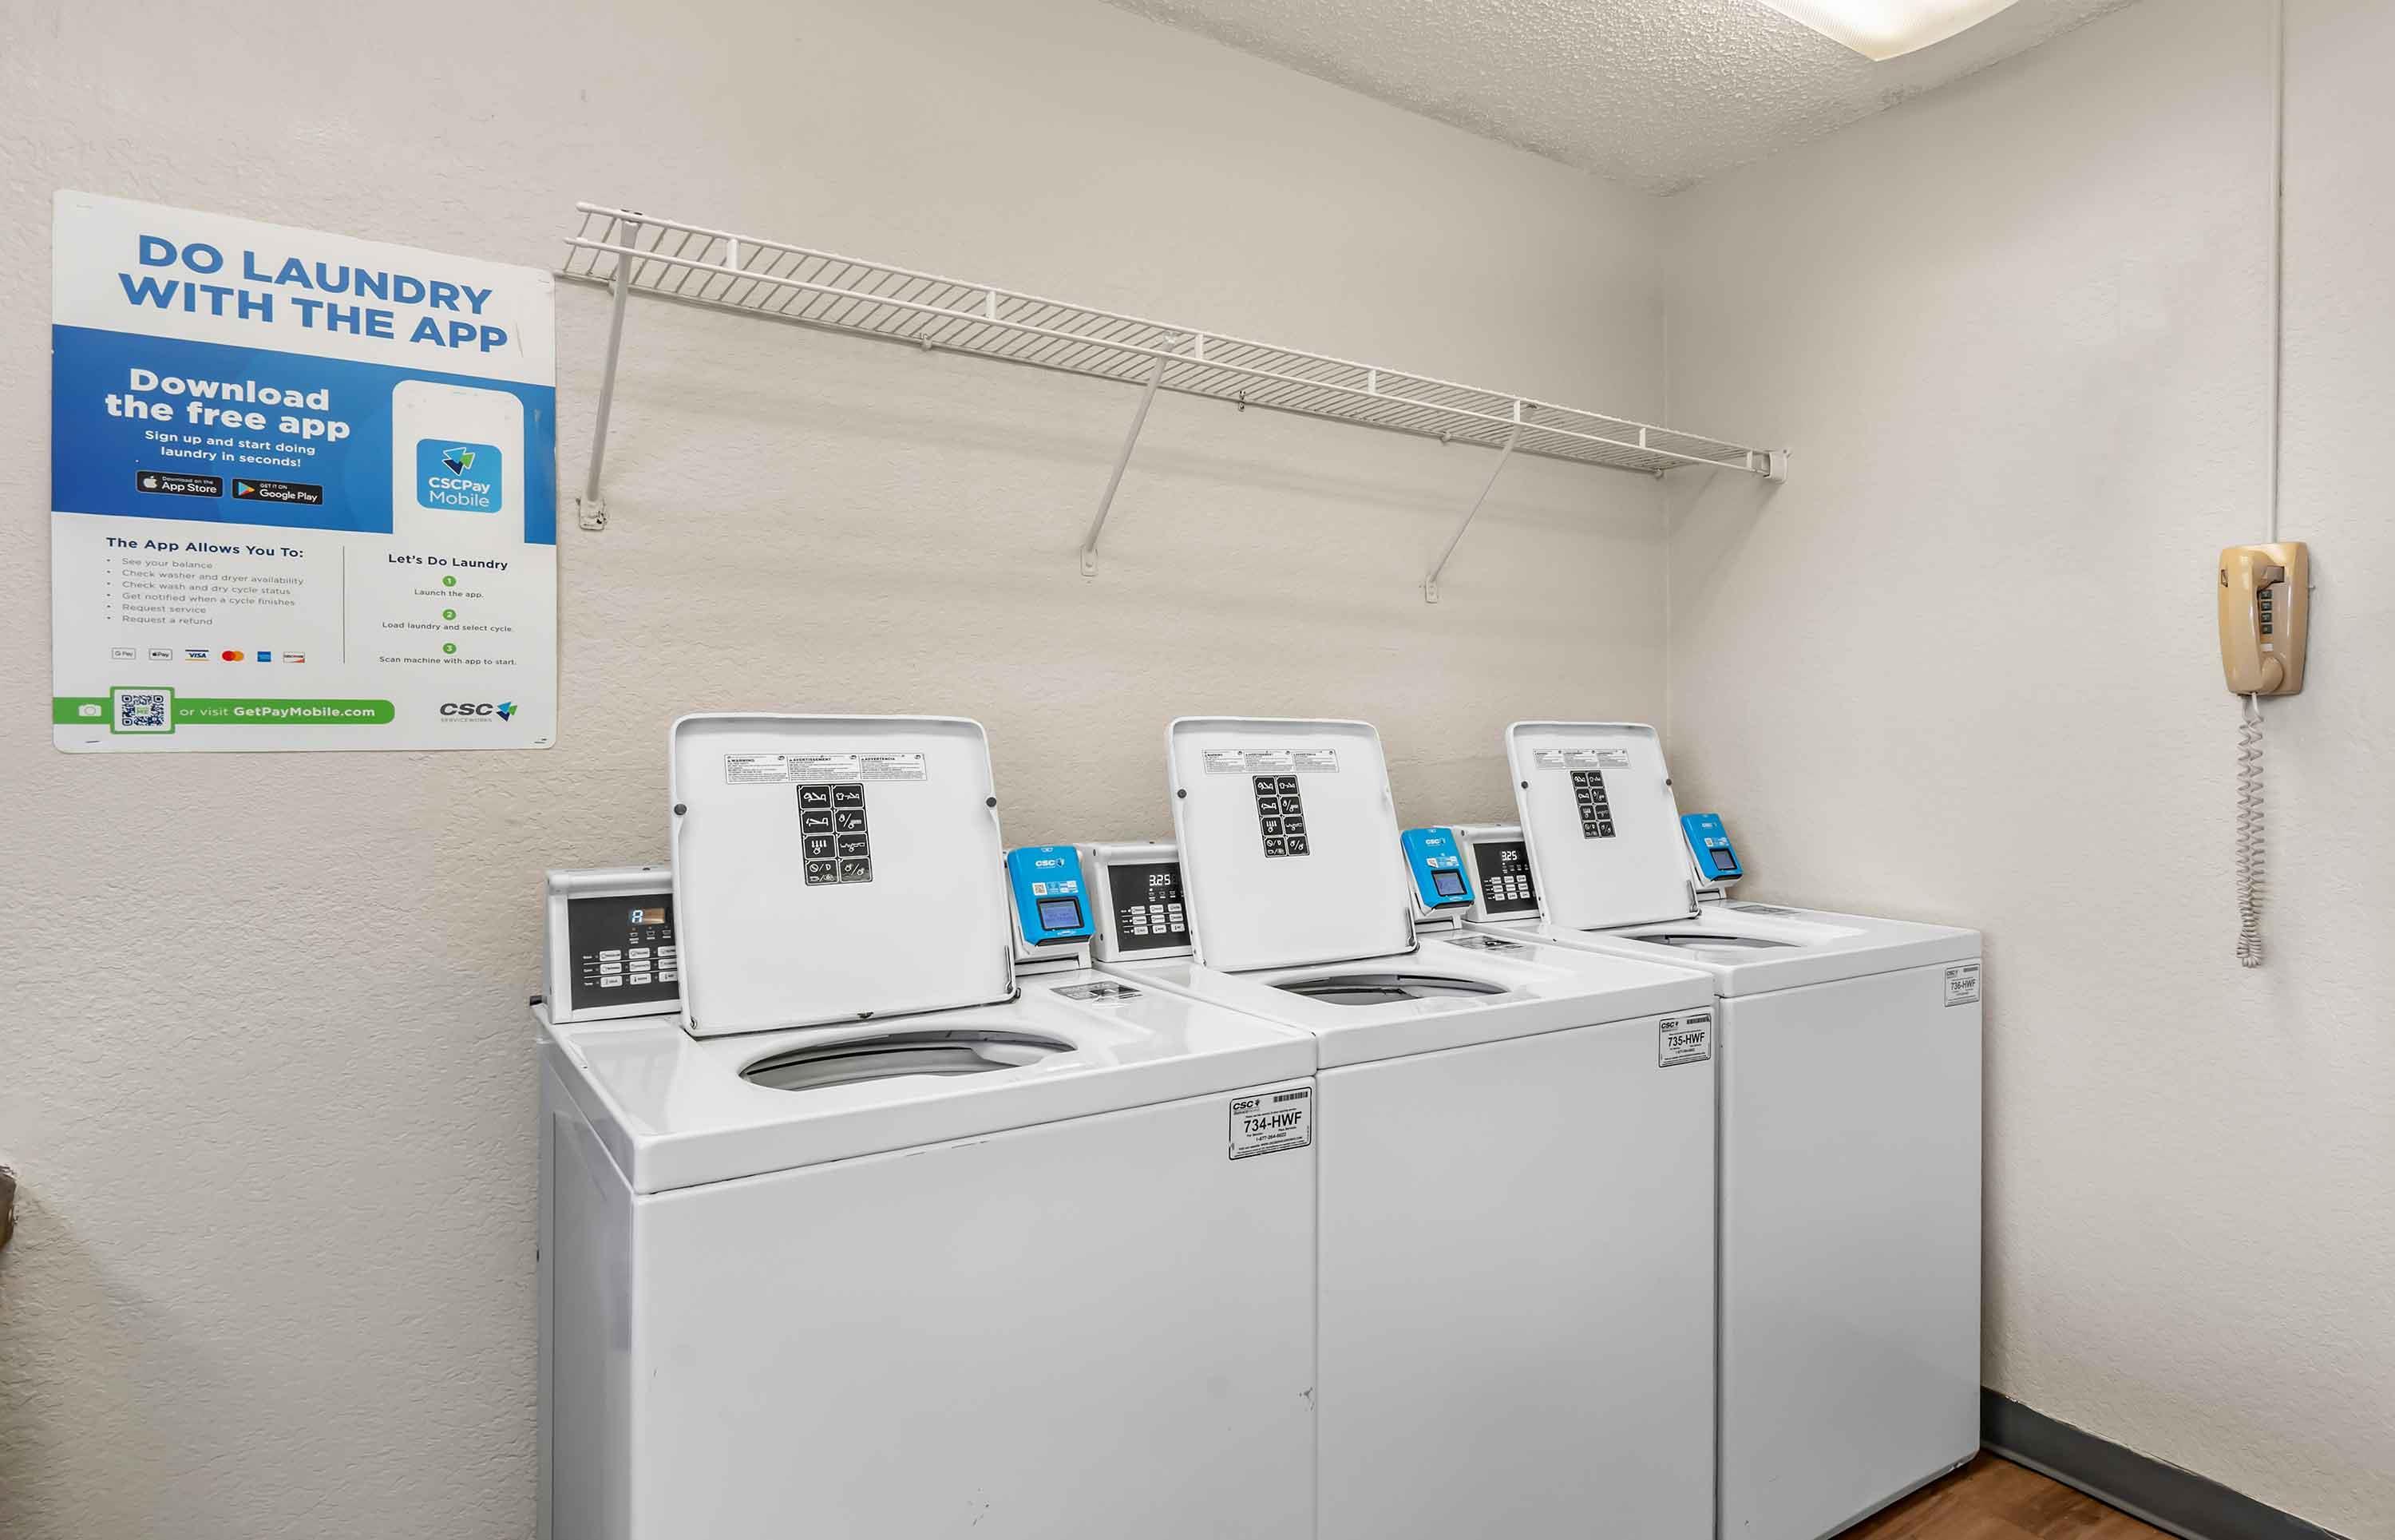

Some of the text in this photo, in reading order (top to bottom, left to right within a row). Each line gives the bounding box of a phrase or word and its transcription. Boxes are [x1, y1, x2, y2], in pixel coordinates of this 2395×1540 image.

[139, 234, 493, 315] DO LAUNDRY
[118, 273, 509, 353] WITH THE APP
[130, 368, 329, 411] Download
[105, 394, 350, 442] the free app
[144, 430, 316, 457] Sign up and start doing
[160, 446, 301, 467] laundry in seconds!
[161, 481, 217, 493] App Store
[429, 477, 491, 494] CSCPay
[259, 489, 318, 502] Google Play
[430, 490, 490, 507] Mobile
[106, 537, 304, 557] The App Allows You To:
[172, 560, 213, 569] balance
[428, 556, 447, 566] Do
[453, 558, 508, 571] Laundry
[122, 569, 155, 578] Check
[221, 574, 248, 584] dryer
[251, 575, 304, 585] availability
[212, 585, 228, 594] dry
[232, 586, 259, 595] cycle
[145, 593, 186, 602] notified
[229, 596, 255, 605] cycle
[258, 598, 295, 607] finishes
[122, 604, 207, 614] Request service
[122, 616, 166, 624] Request
[180, 706, 375, 719] or visit GetPayMobile.com
[440, 703, 493, 716] CSC
[1150, 874, 1170, 886] 3.25
[1668, 1031, 1705, 1047] 735-HWF
[1233, 1101, 1254, 1110] CSC
[1244, 1110, 1302, 1133] 734-HWF
